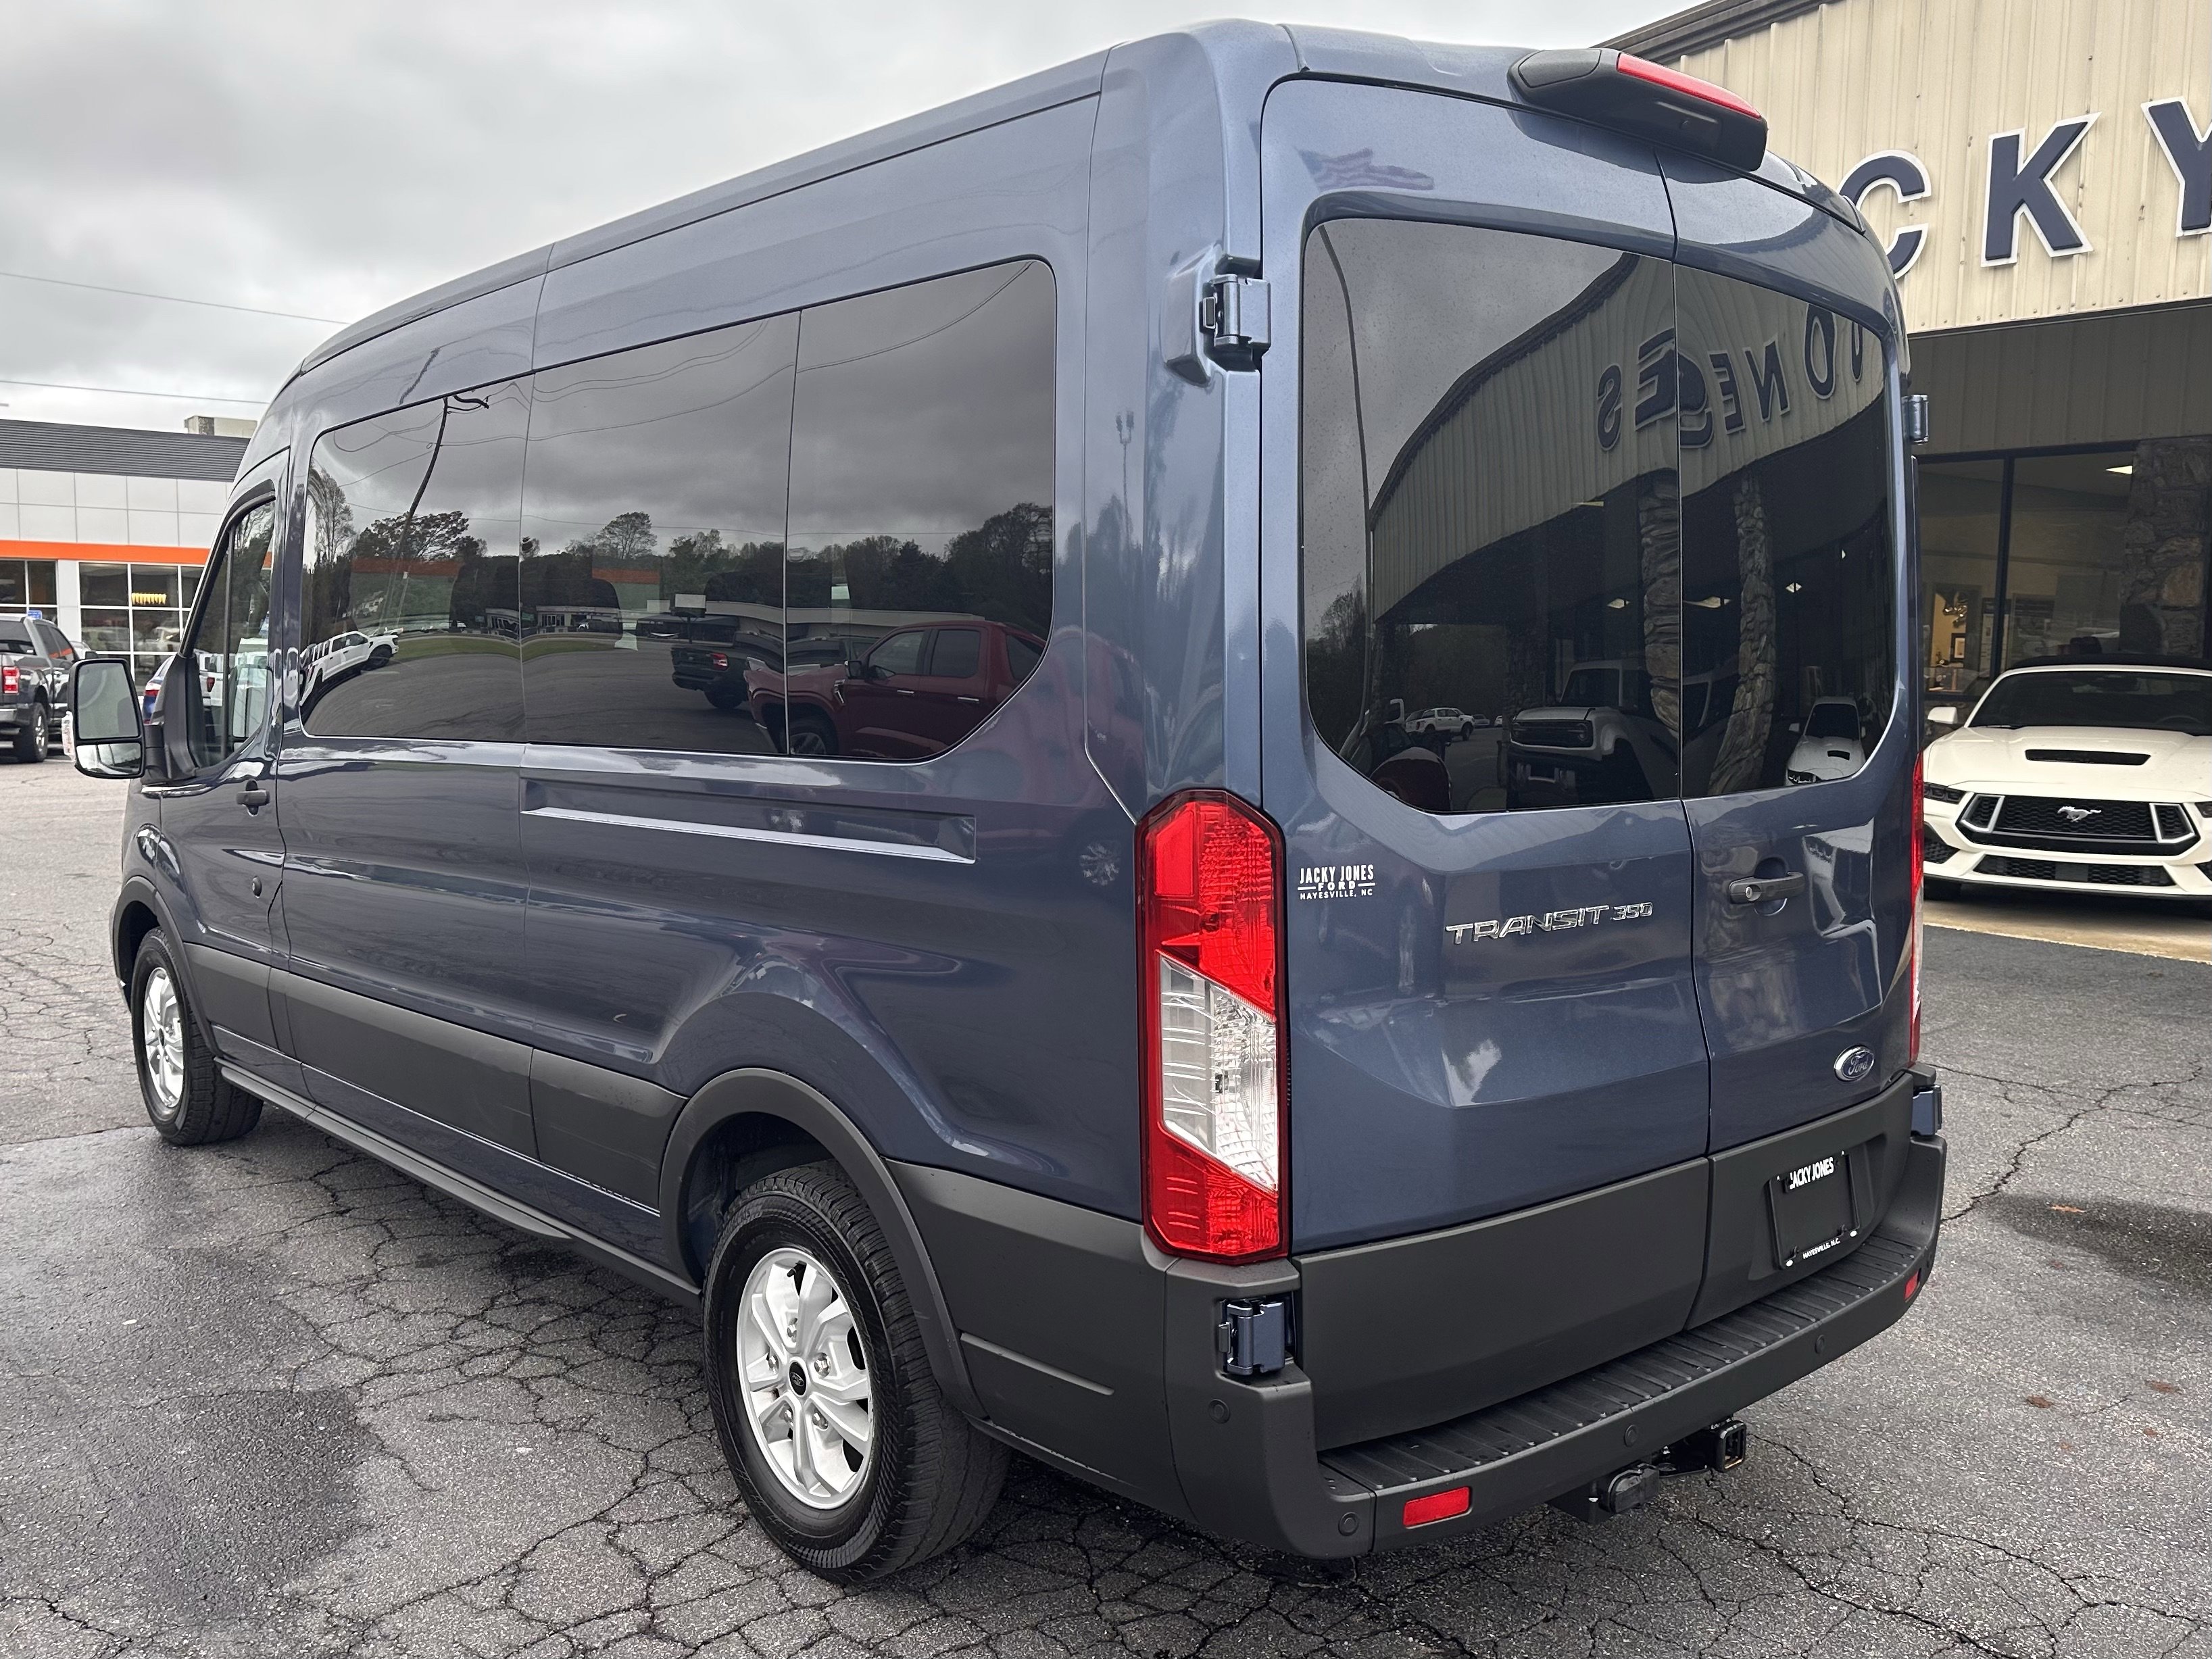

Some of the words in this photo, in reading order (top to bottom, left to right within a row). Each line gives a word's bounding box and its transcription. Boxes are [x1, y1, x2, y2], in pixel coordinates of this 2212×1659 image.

[1300, 866, 1335, 884] JACKY
[1340, 864, 1373, 882] JONES
[1318, 881, 1356, 891] FORD
[1361, 888, 1373, 896] NC
[1446, 905, 1609, 945] TRANSIT
[1611, 901, 1653, 921] 350
[1848, 1054, 1869, 1075] Ford
[1789, 1166, 1811, 1190] JACKY
[1812, 1156, 1834, 1181] JONES
